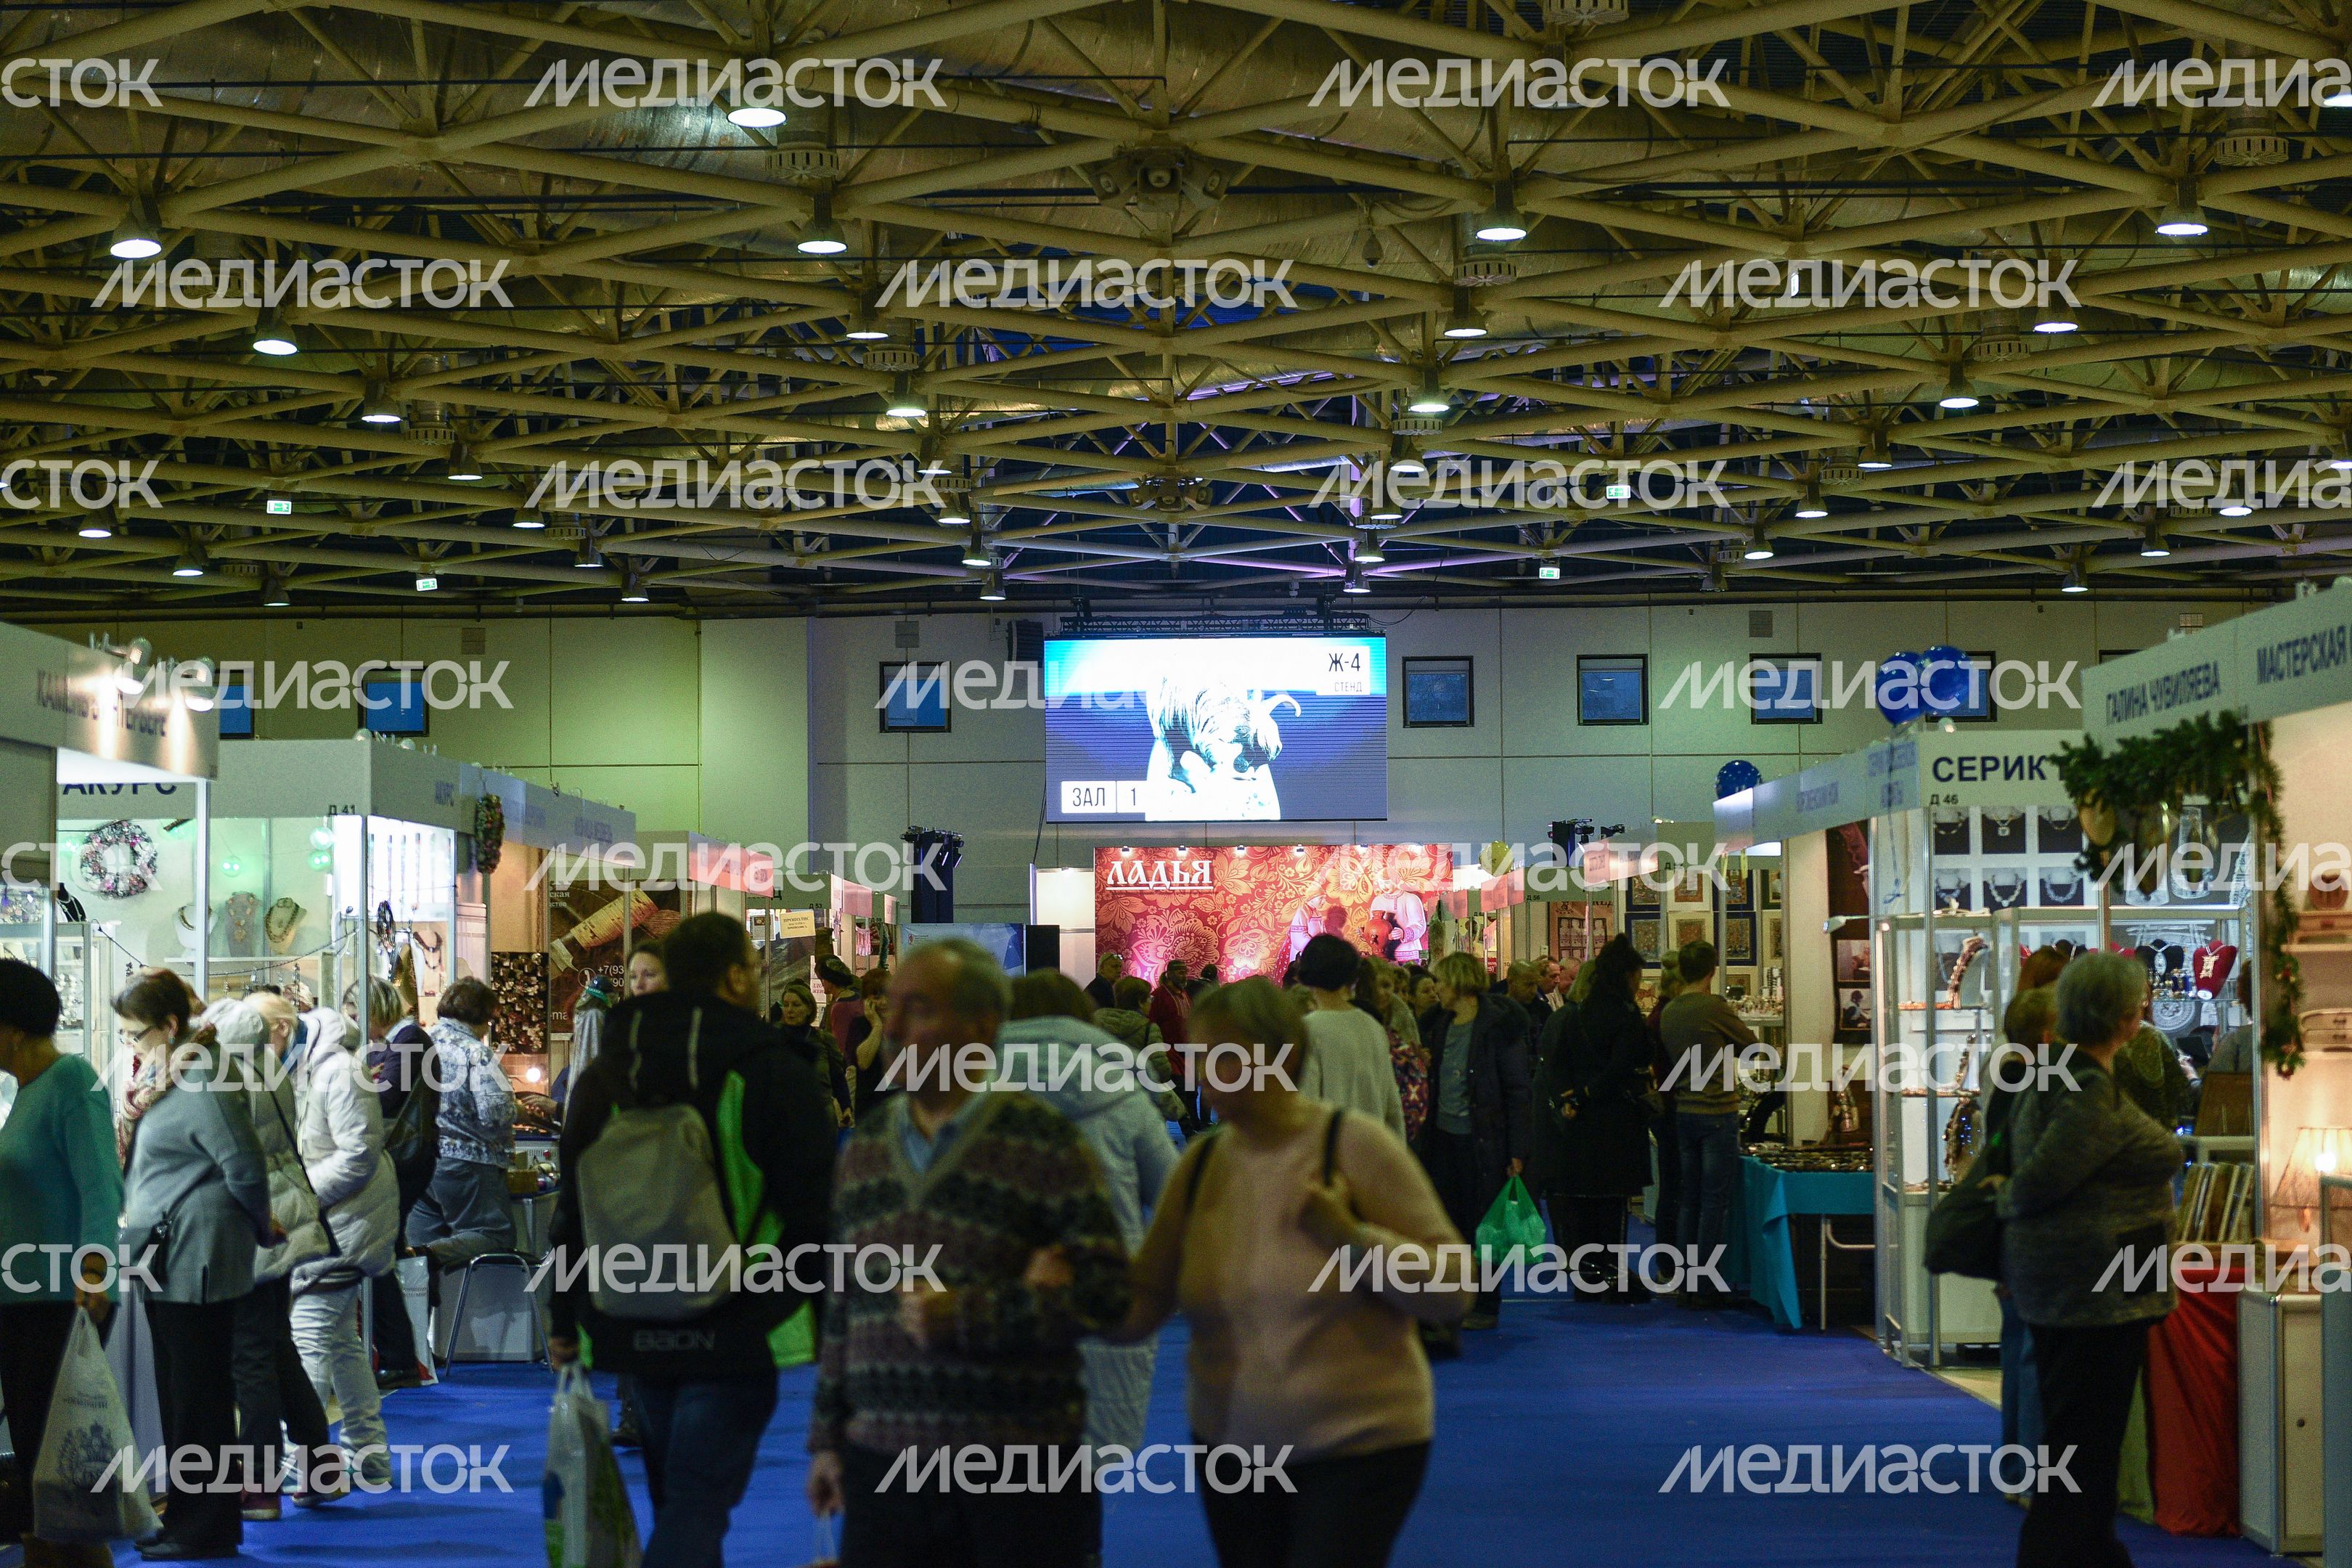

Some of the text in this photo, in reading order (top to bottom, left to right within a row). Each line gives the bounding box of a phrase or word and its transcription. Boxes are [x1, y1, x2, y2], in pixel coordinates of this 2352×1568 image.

[1328, 653, 1360, 671] Ж-4
[1334, 682, 1362, 693] СТЕНД
[1932, 754, 2047, 782] СЕРИК
[1072, 787, 1135, 807] ЗАЛ 1
[1930, 794, 1959, 806] Д 46
[328, 804, 355, 817] Д 41
